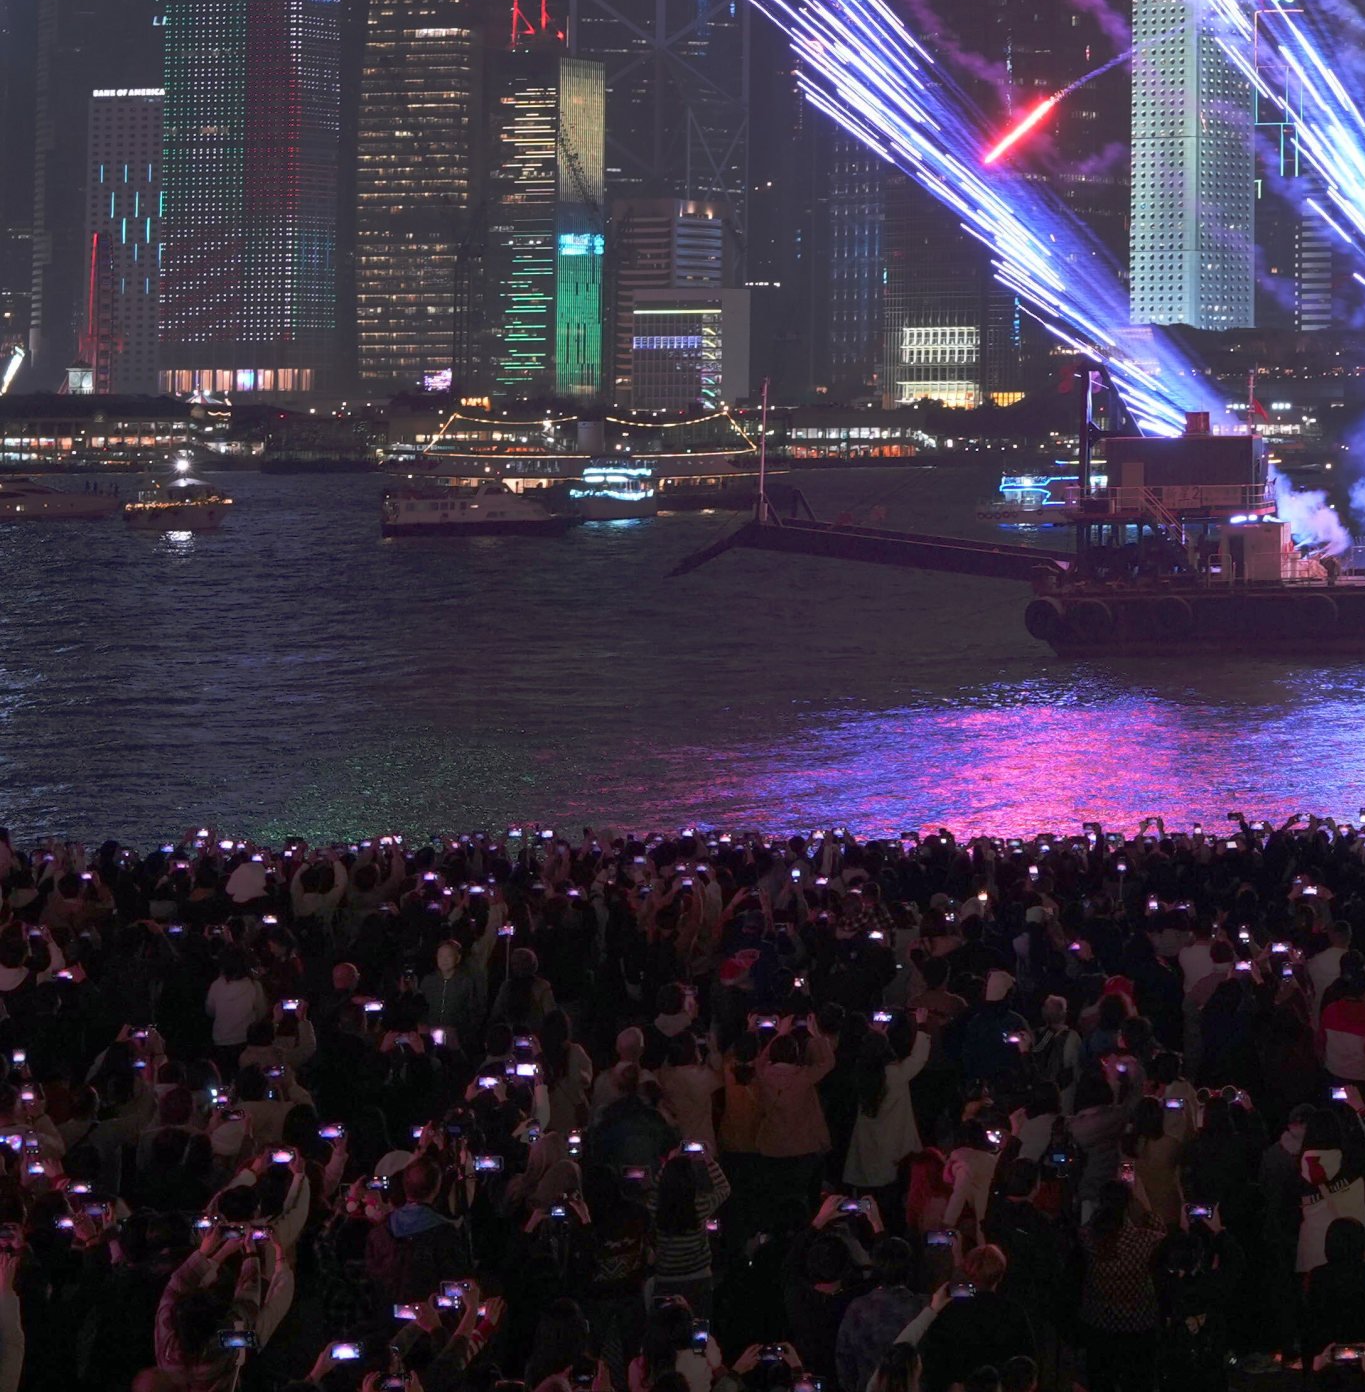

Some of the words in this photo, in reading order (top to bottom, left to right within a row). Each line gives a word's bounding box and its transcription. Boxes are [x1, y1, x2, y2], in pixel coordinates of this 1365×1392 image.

[92, 89, 116, 97] BANK
[116, 88, 128, 97] OF
[128, 88, 166, 96] AMERICA
